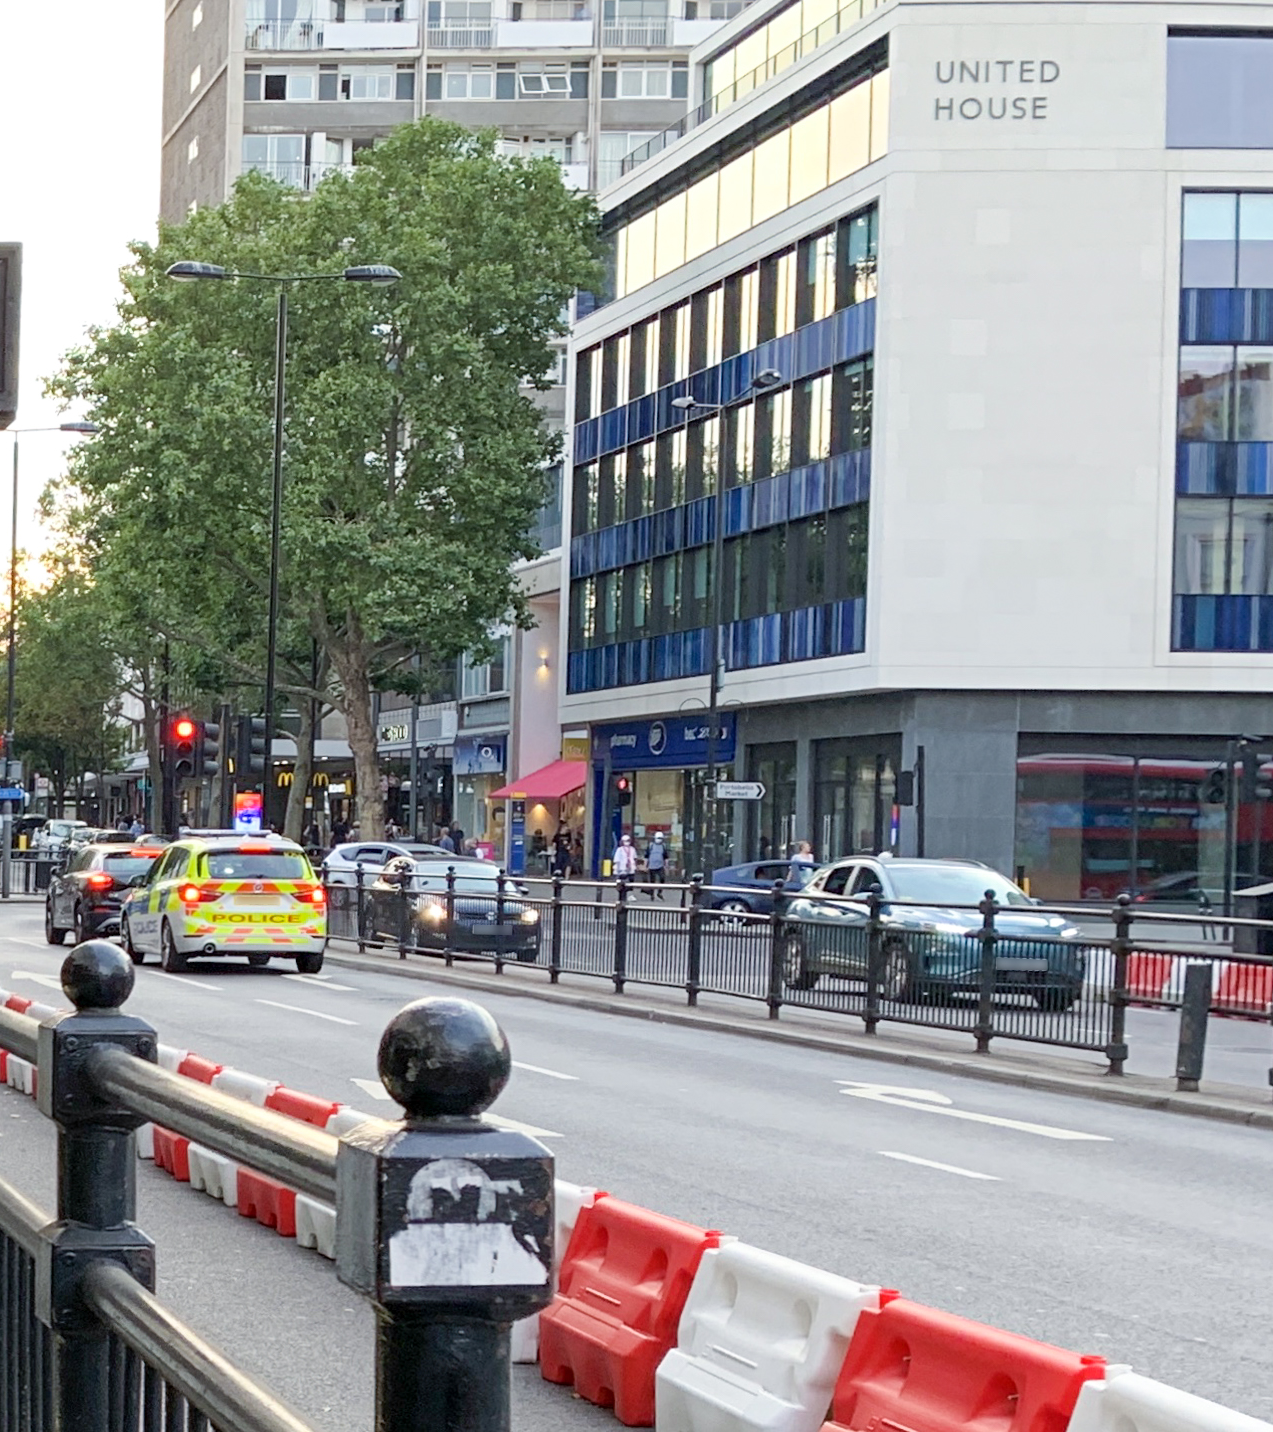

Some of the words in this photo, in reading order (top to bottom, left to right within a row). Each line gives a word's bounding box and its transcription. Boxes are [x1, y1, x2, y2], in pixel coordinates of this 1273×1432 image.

[936, 59, 1061, 85] UNITED
[935, 96, 1049, 121] HOUSE
[212, 914, 301, 923] POLICE
